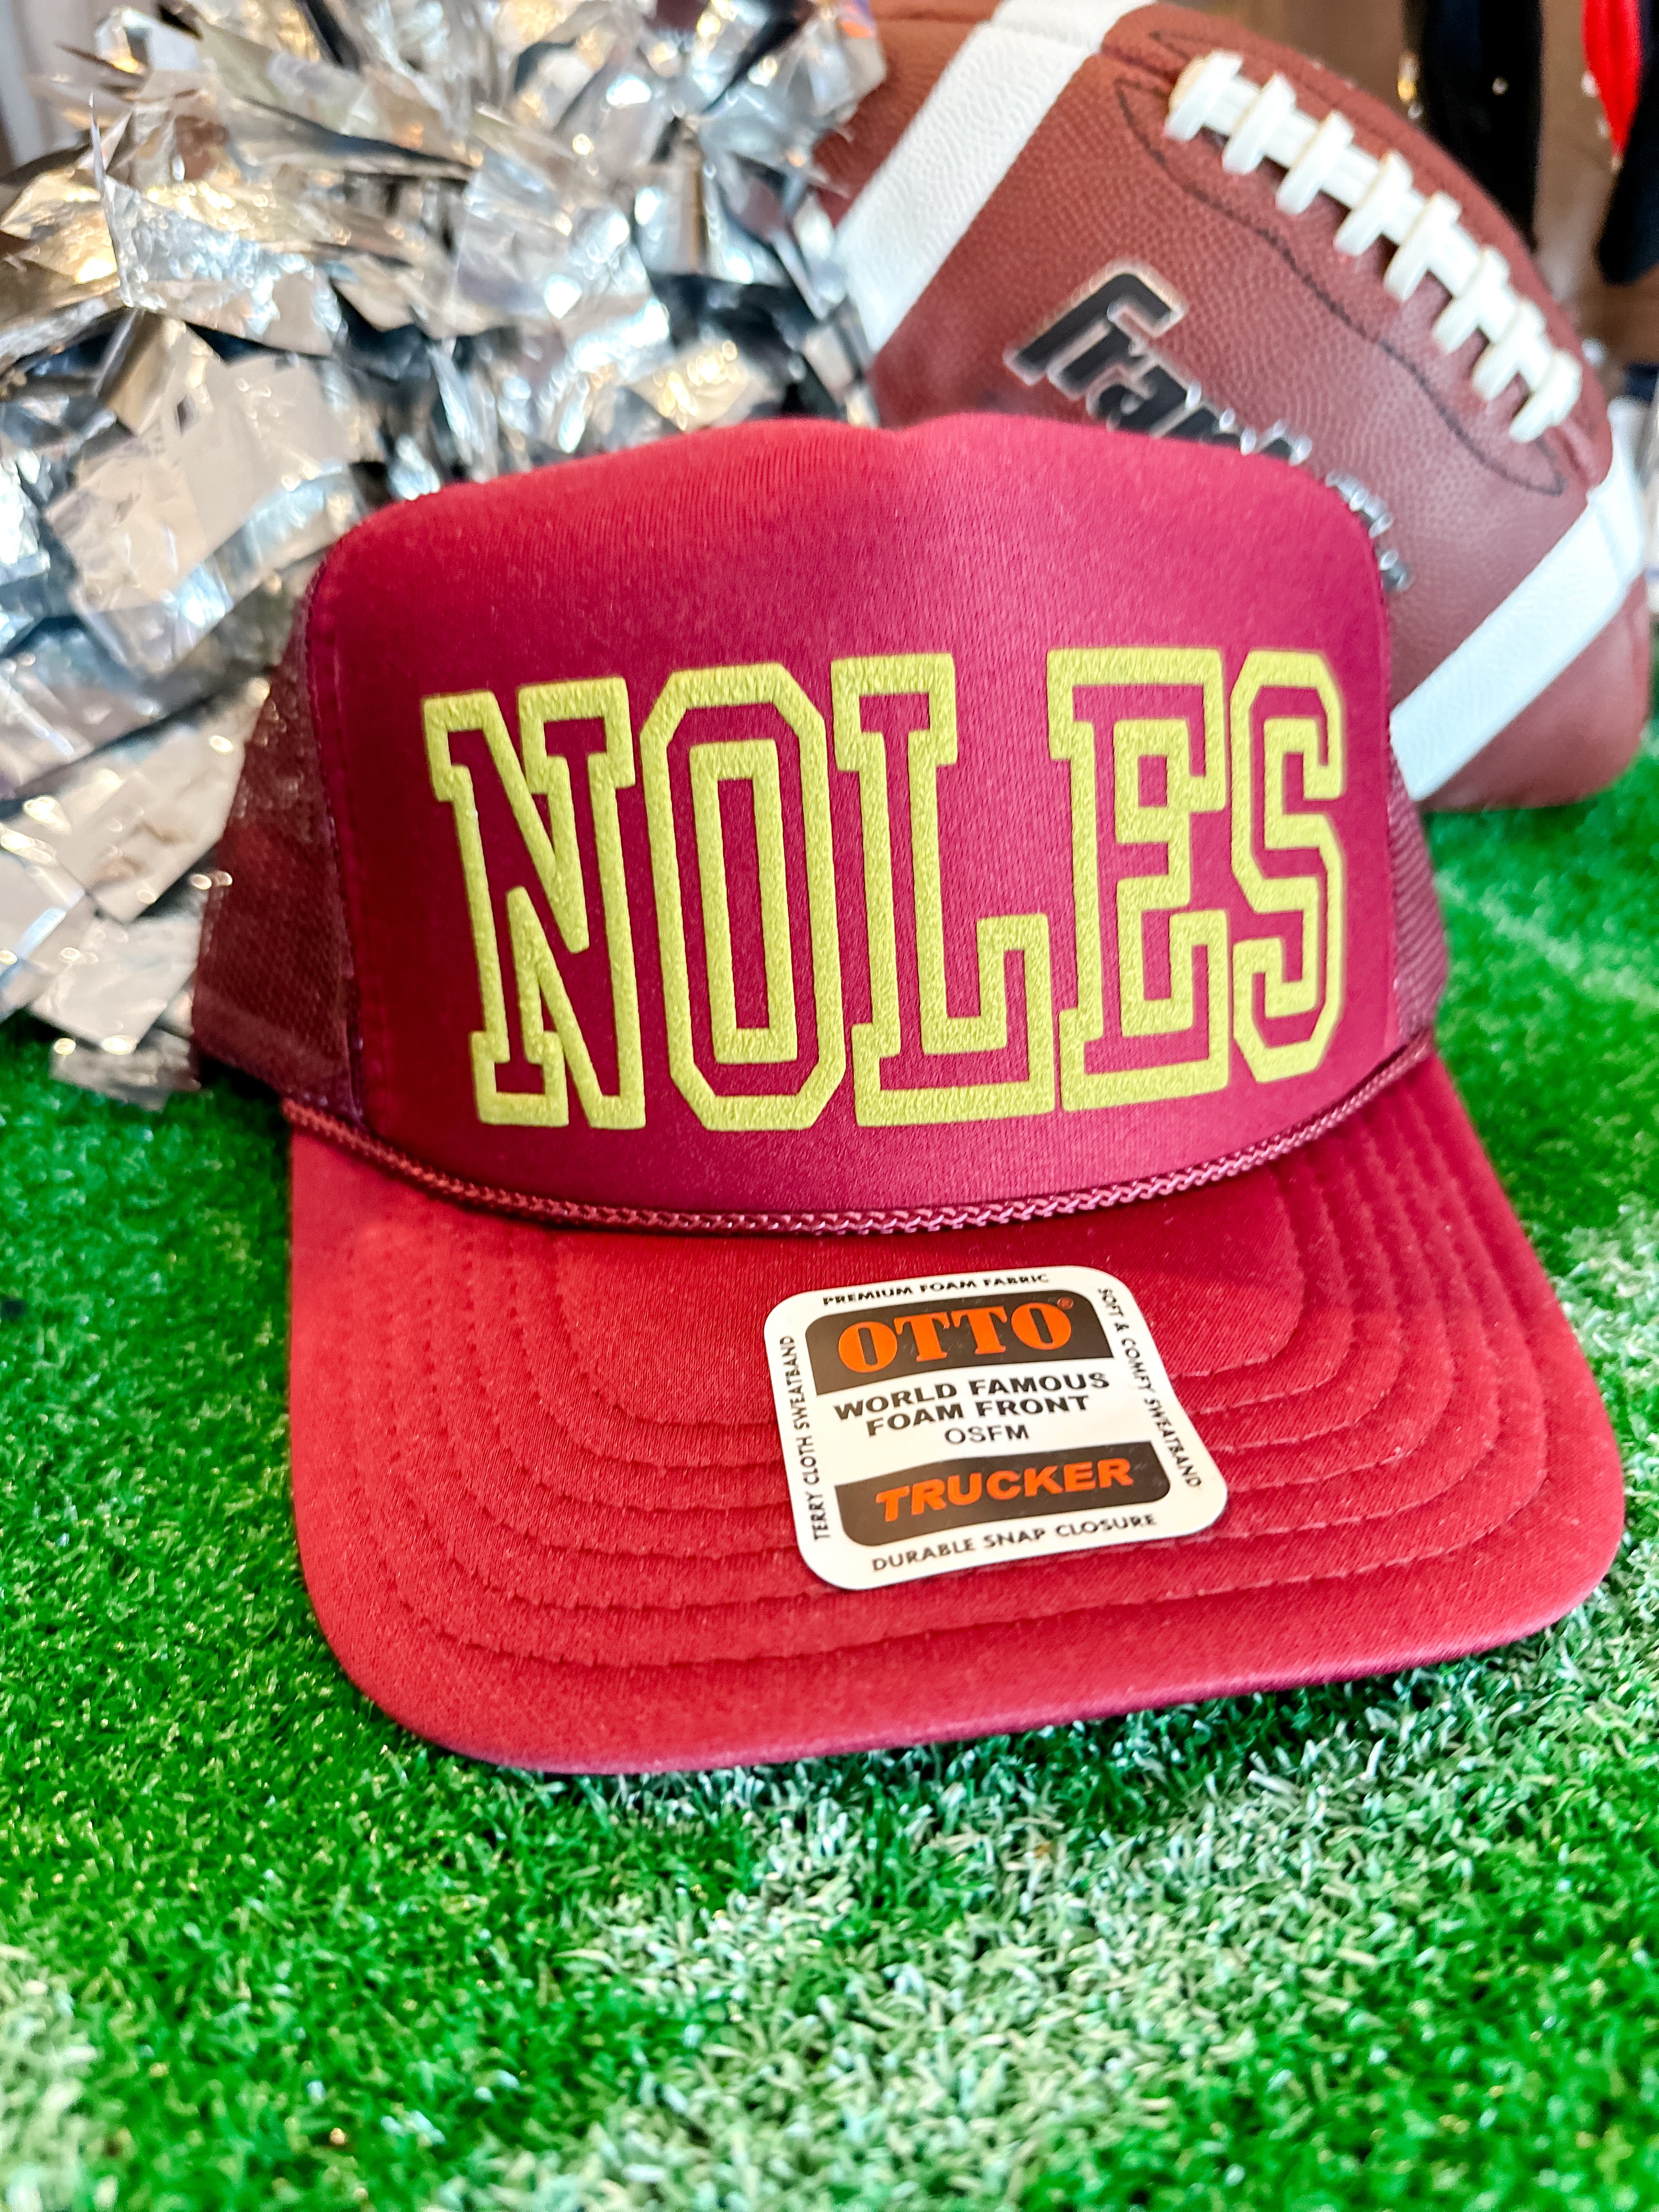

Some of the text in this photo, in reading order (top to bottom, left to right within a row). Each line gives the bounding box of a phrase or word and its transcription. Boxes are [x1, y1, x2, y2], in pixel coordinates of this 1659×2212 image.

[421, 647, 1344, 1131] NOLES
[822, 1273, 1050, 1306] PREMIUM FOAM FABRIC
[834, 1372, 1110, 1420] WORLD FAMOUS
[866, 1396, 1090, 1437] FOAM FRONT
[1098, 1288, 1201, 1487] SOFT & COMFY SWEATBAND
[780, 1335, 831, 1541] TERRY CLOTH SWEATBAND
[944, 1424, 1030, 1444] OSFM
[875, 1458, 1134, 1523] TRUCKER
[871, 1514, 1158, 1572] DURABLE SNAP CLOSURE
